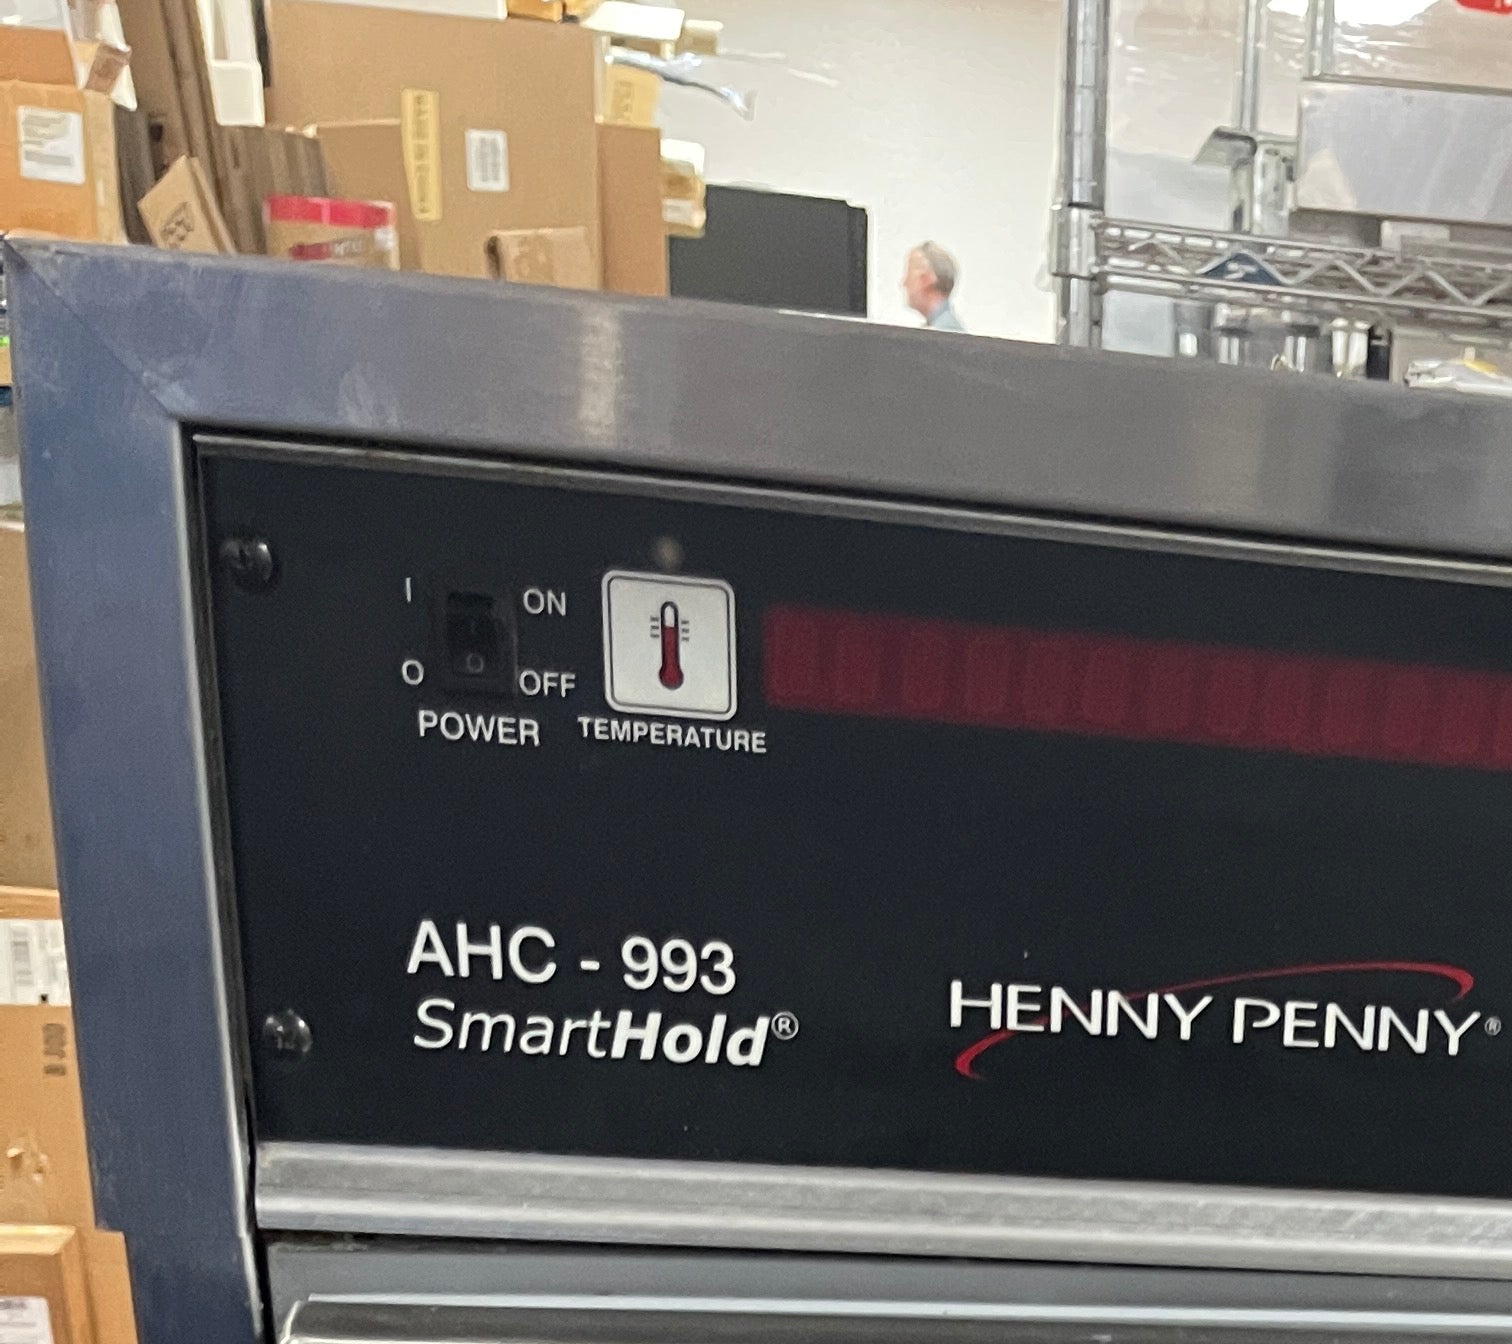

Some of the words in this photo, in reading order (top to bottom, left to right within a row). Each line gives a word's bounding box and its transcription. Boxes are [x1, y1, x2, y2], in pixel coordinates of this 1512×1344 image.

[522, 588, 567, 616] ON
[518, 669, 576, 698] OFF
[418, 709, 540, 747] POWER
[577, 715, 768, 754] TEMPERATURE
[406, 919, 557, 984] AHC
[621, 935, 736, 995] 993
[950, 979, 1213, 1041] HENNY
